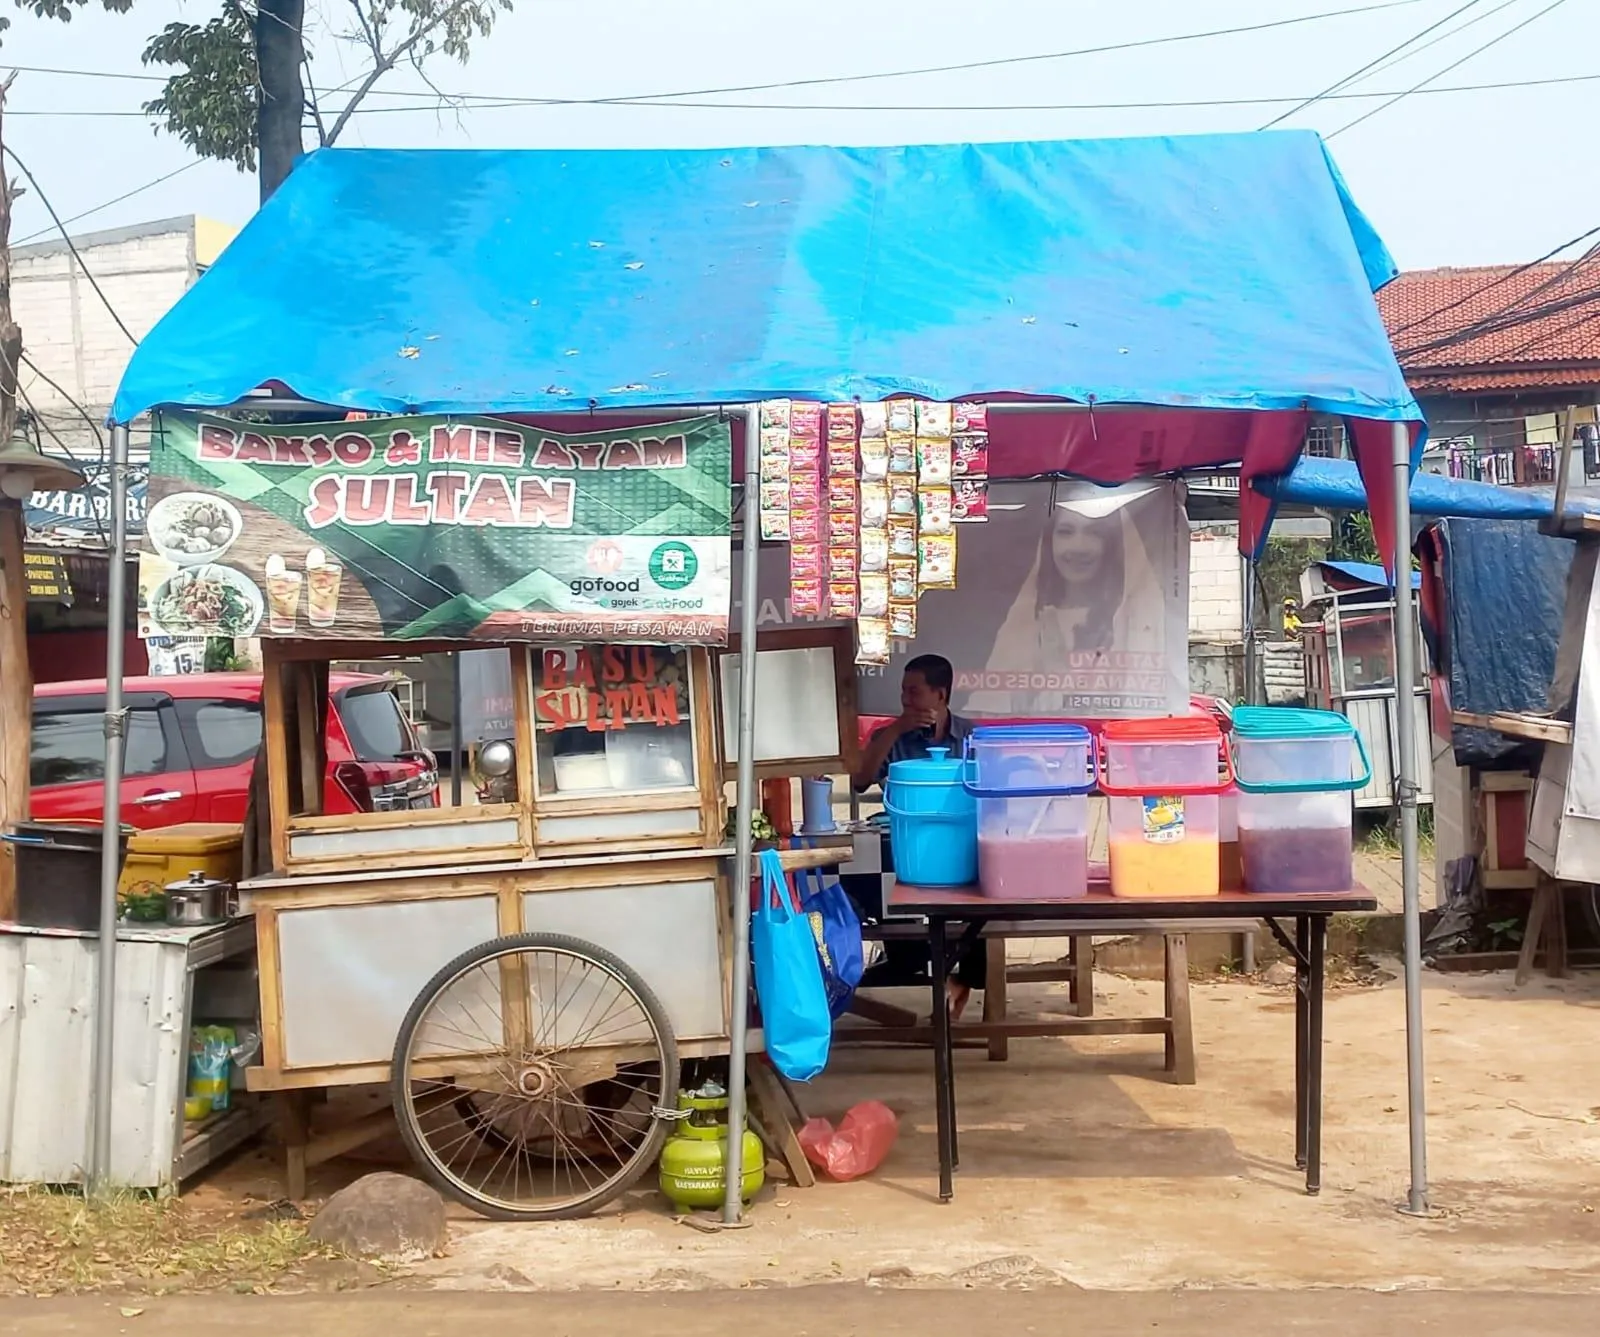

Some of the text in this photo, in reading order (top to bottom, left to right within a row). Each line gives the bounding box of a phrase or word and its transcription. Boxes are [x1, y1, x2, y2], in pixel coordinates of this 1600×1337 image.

[197, 423, 687, 470] BAKSO & MIE AYAM
[28, 490, 147, 521] BARBR
[303, 471, 576, 529] SULTAN
[569, 577, 640, 596] gofood
[611, 598, 638, 608] gojek
[642, 597, 704, 609] GabFood
[520, 618, 714, 637] TERIMA PESANAN
[174, 653, 193, 674] 15
[536, 682, 682, 734] SULTAN
